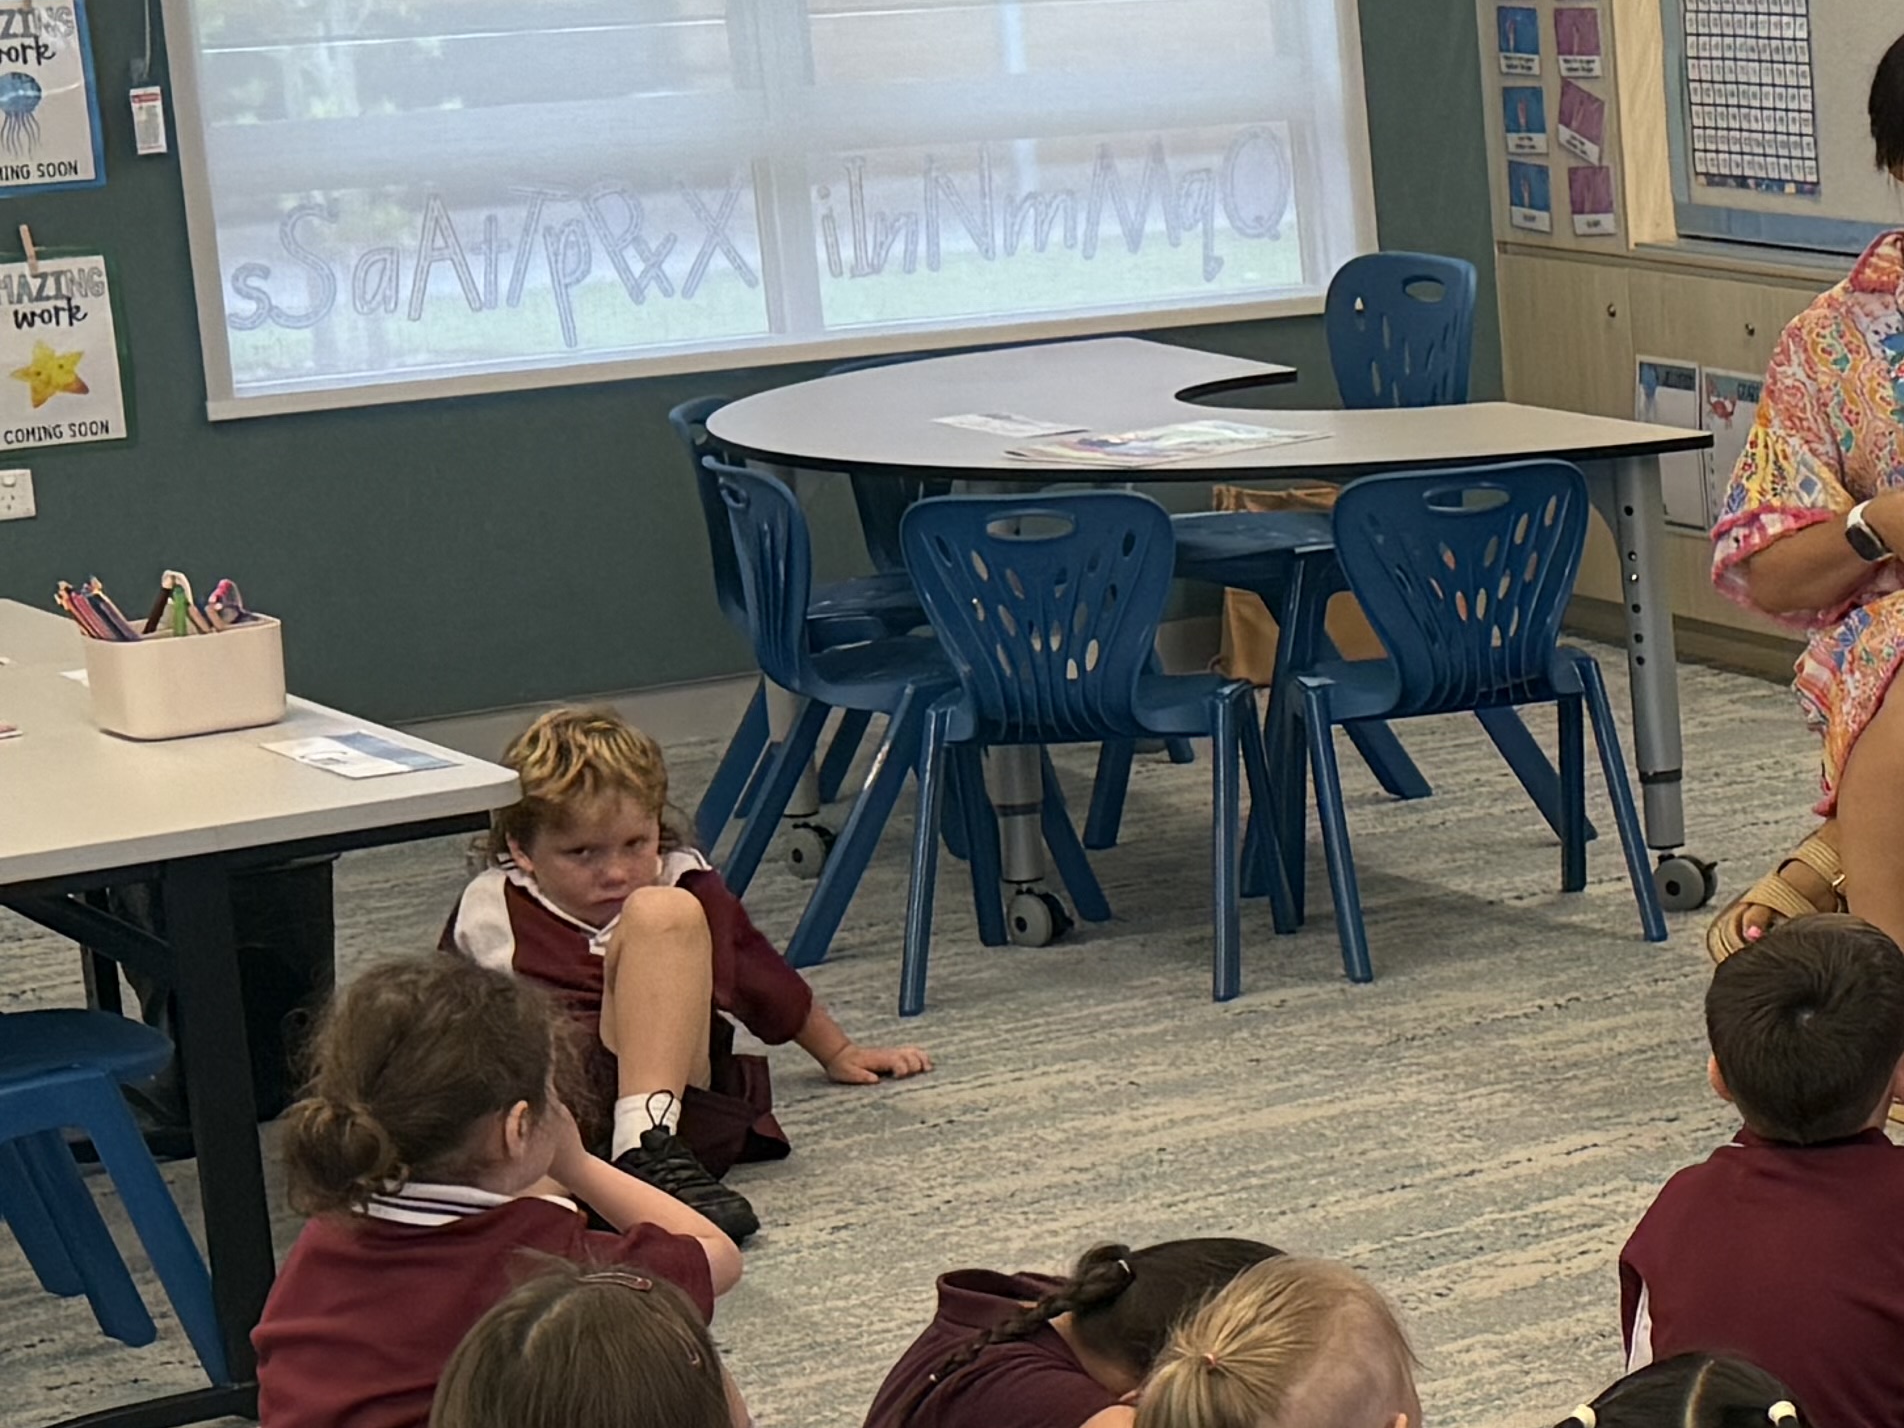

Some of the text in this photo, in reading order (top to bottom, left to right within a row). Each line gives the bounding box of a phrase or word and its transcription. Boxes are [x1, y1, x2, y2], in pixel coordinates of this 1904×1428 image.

[36, 160, 79, 179] SOON
[14, 296, 89, 330] work
[4, 420, 110, 446] COMING SOON
